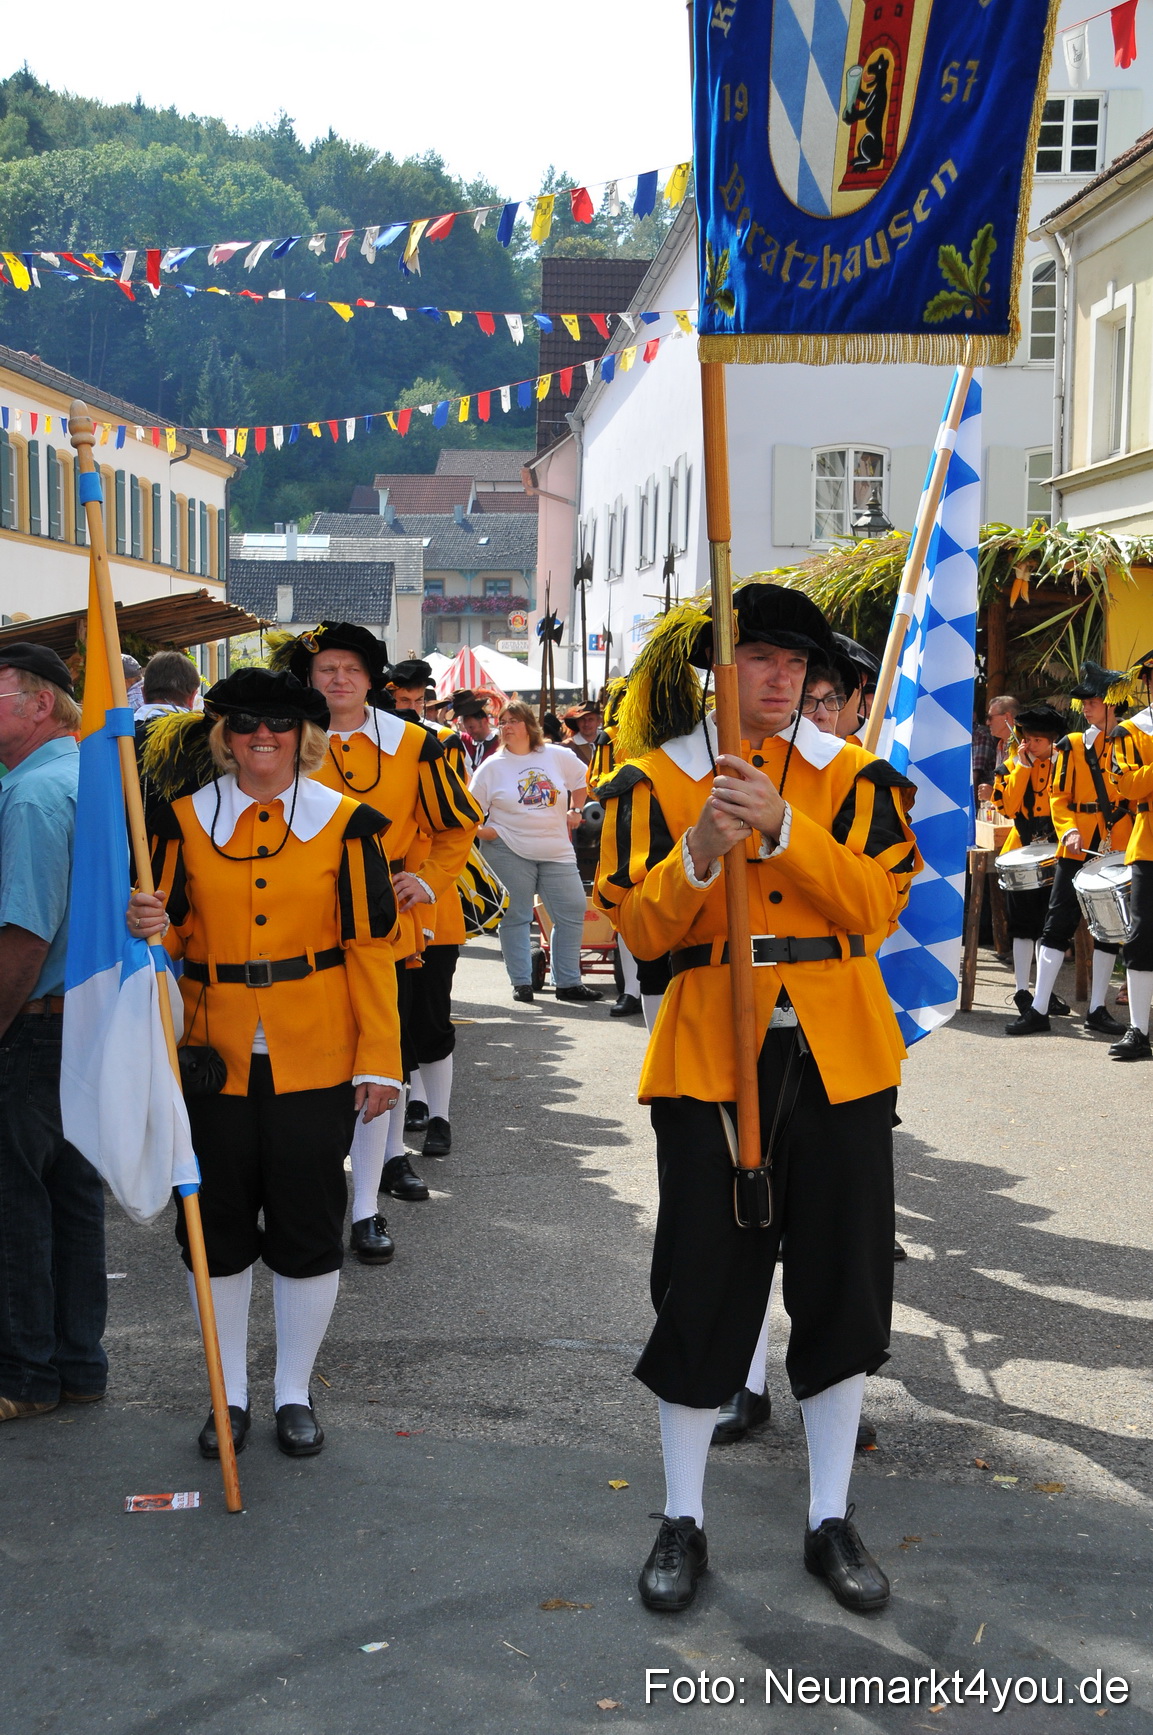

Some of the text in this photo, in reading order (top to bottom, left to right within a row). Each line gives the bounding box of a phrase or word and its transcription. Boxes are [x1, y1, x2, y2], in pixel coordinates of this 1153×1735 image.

[722, 60, 980, 122] 19 57
[718, 158, 959, 290] Beratzhausen
